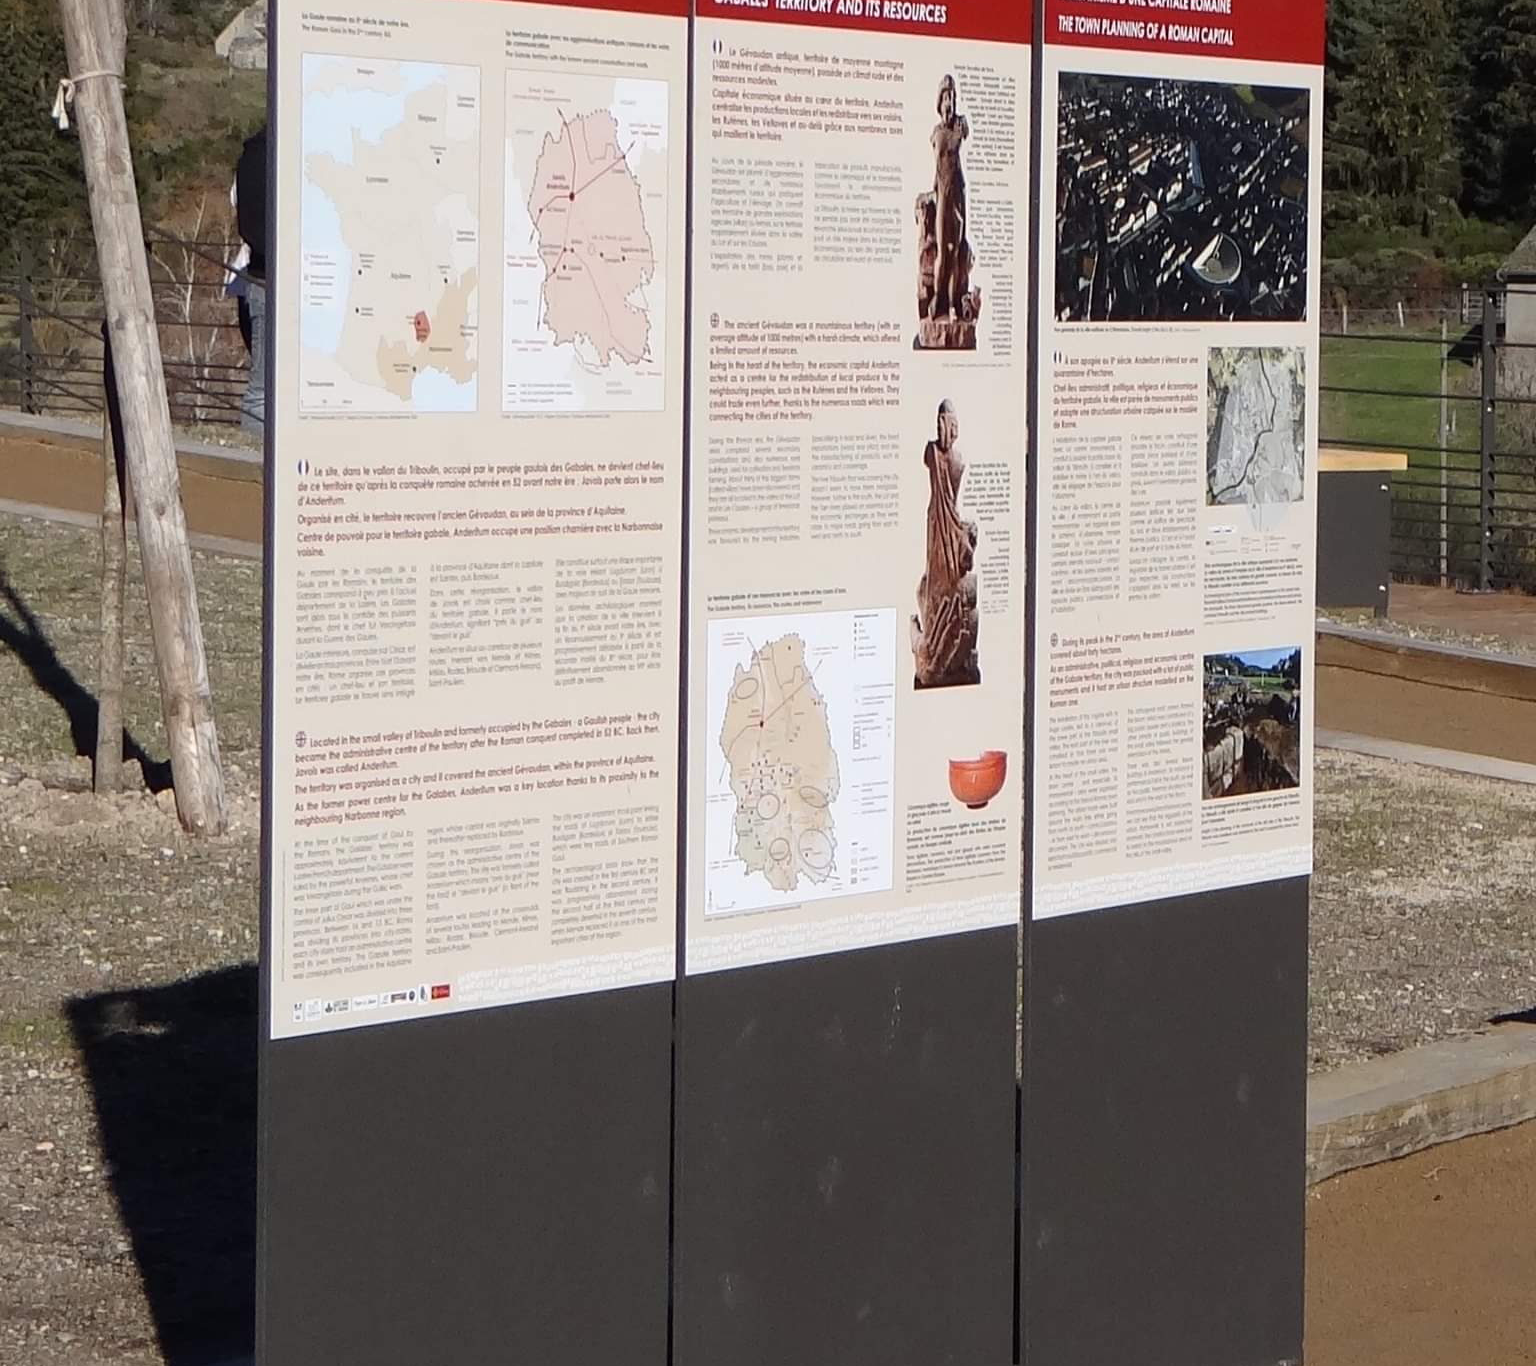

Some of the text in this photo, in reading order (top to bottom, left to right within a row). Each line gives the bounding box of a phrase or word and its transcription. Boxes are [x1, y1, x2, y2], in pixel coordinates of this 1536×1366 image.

[882, 1, 946, 23] RESOURCES
[1058, 15, 1233, 46] THE TOWN PLANNING OF A ROMAN CAPITAL
